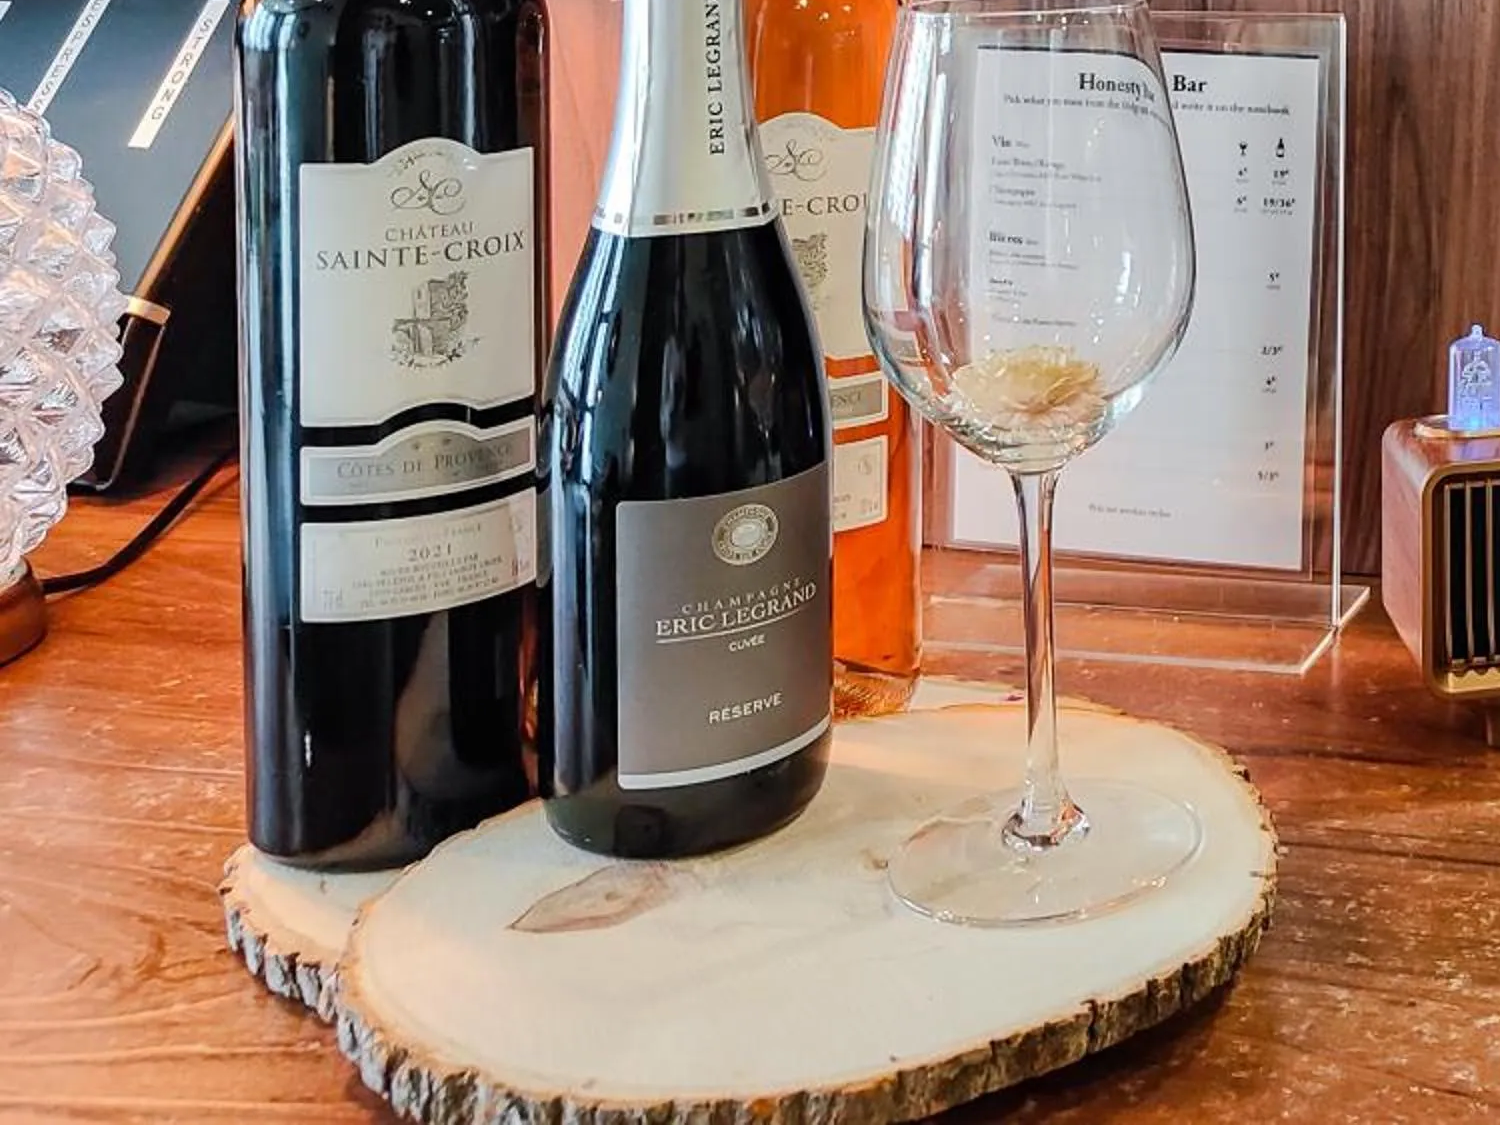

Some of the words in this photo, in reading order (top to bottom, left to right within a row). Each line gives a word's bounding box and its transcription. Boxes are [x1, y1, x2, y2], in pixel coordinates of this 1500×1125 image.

[1078, 72, 1141, 102] Honesty
[1172, 74, 1208, 93] Bar
[708, 101, 726, 155] ERIC
[316, 229, 526, 271] SAINTE-CROIX
[385, 220, 475, 242] CHÂTEAU
[408, 542, 453, 563] 2021
[656, 614, 718, 636] ERIC
[722, 582, 817, 628] LEGRAND
[681, 577, 801, 615] CHAMPAGNE
